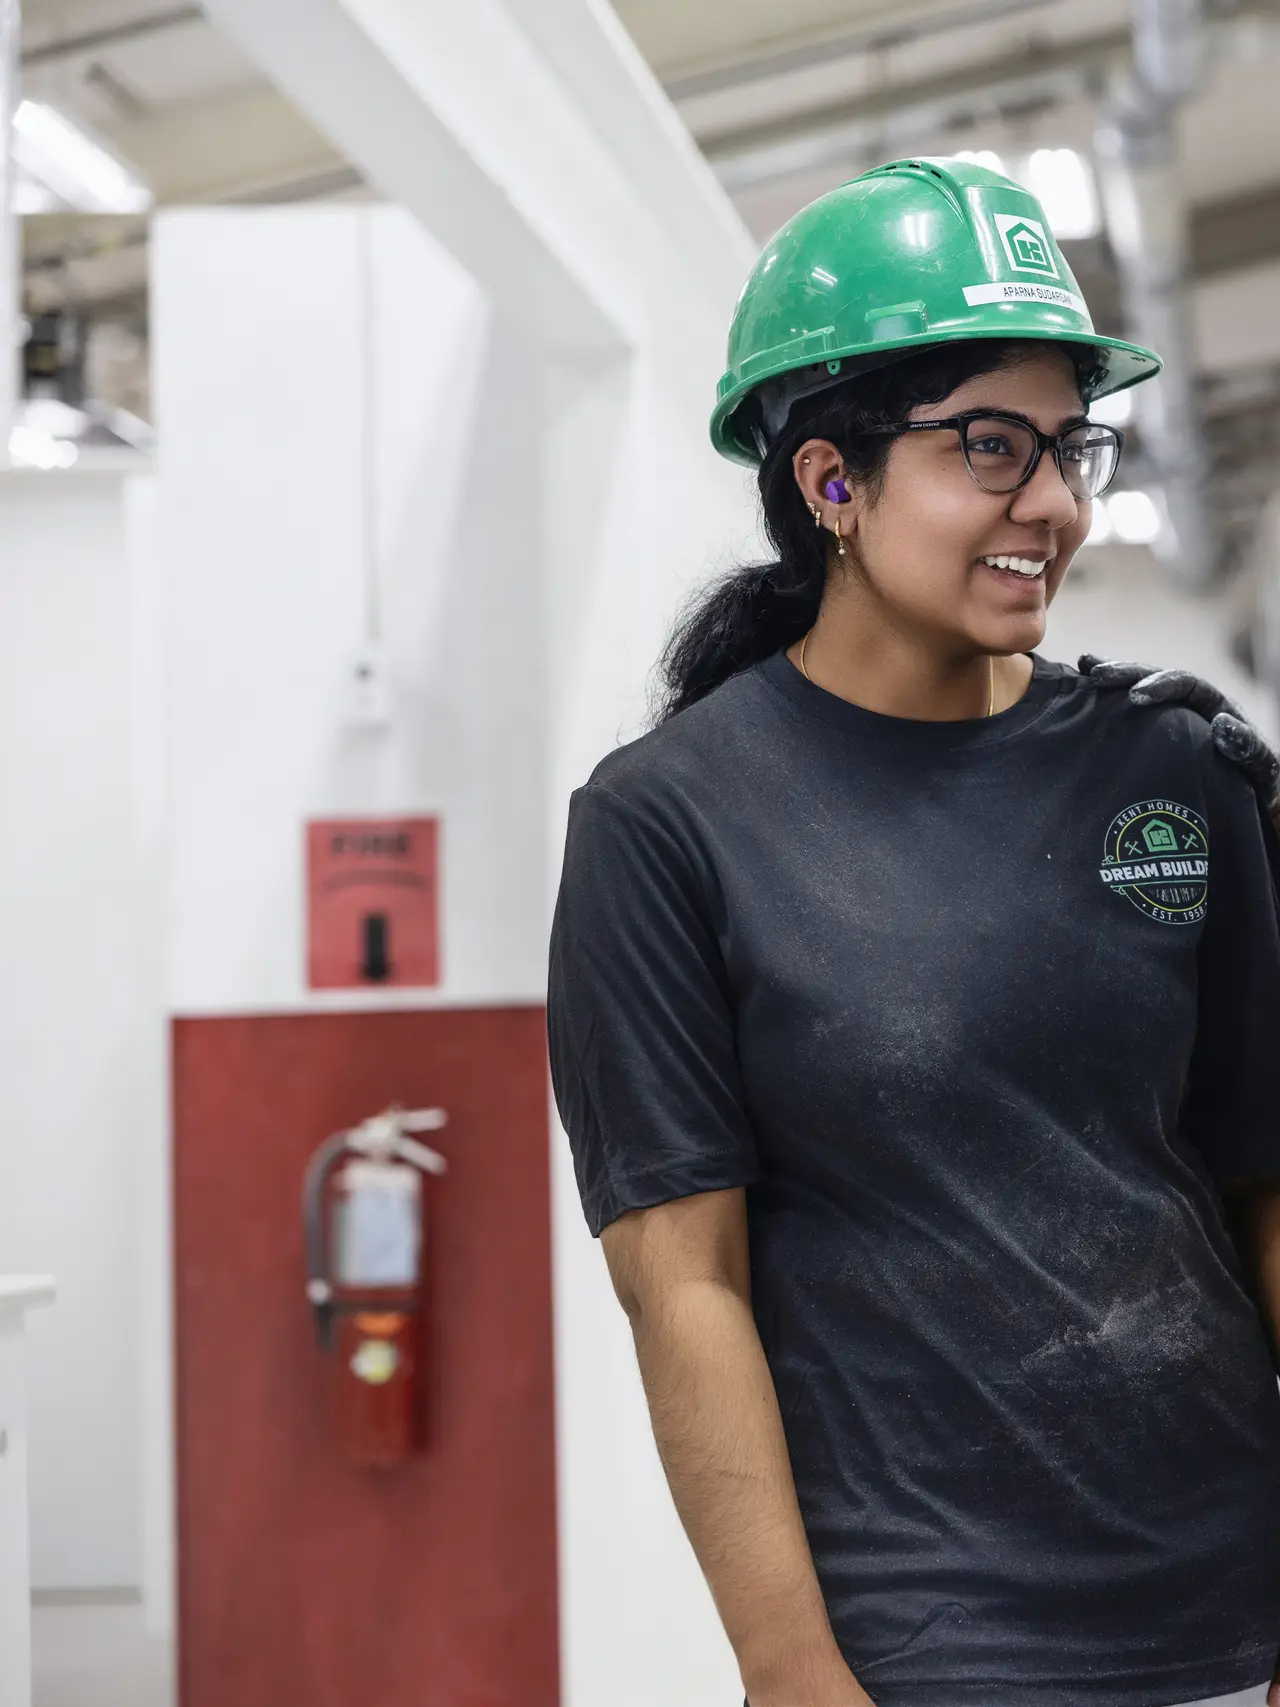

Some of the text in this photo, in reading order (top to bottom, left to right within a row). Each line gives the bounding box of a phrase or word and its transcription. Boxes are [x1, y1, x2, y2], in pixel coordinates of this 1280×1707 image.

[1003, 286, 1037, 298] APARNA
[1116, 802, 1188, 827] KENT HOMES
[1099, 863, 1160, 883] DREAM
[1152, 905, 1205, 921] EST. 1958
